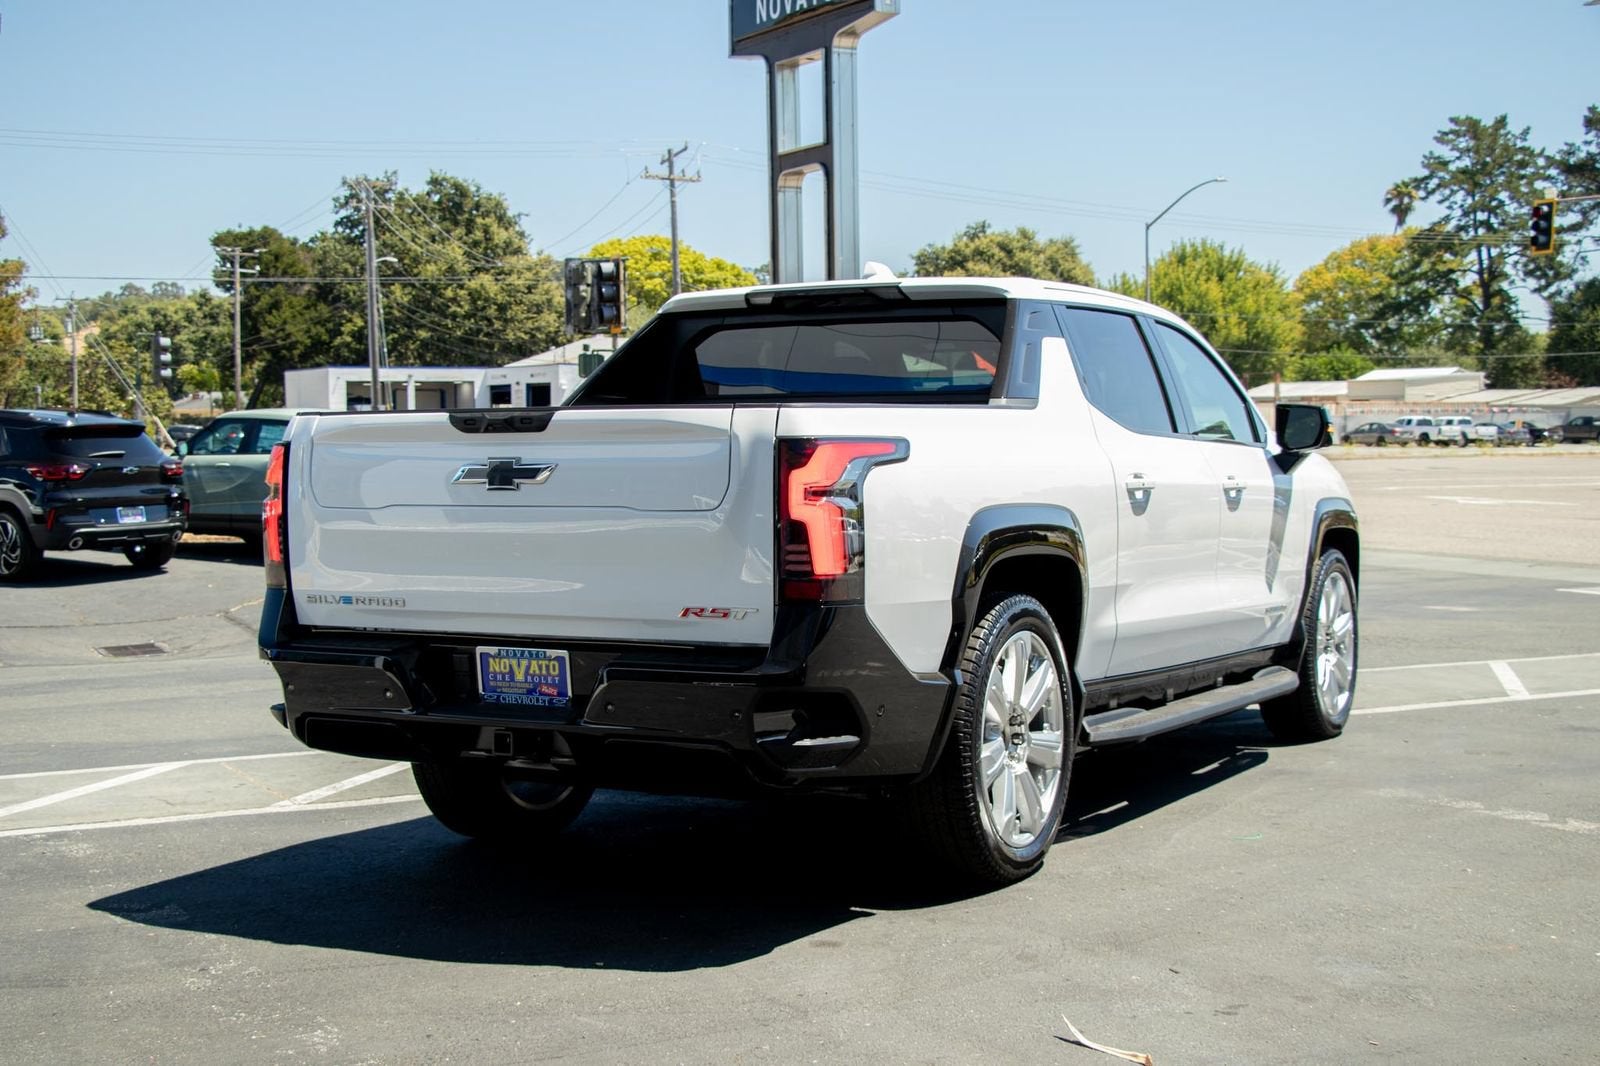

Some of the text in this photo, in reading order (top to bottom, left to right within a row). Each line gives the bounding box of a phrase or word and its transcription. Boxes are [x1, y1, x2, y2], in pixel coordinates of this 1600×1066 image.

[306, 593, 406, 608] SILVERADO
[678, 607, 759, 620] RST
[500, 649, 545, 658] NOVATO
[488, 657, 560, 682] NOVATO
[500, 695, 549, 706] CHEVROLET
